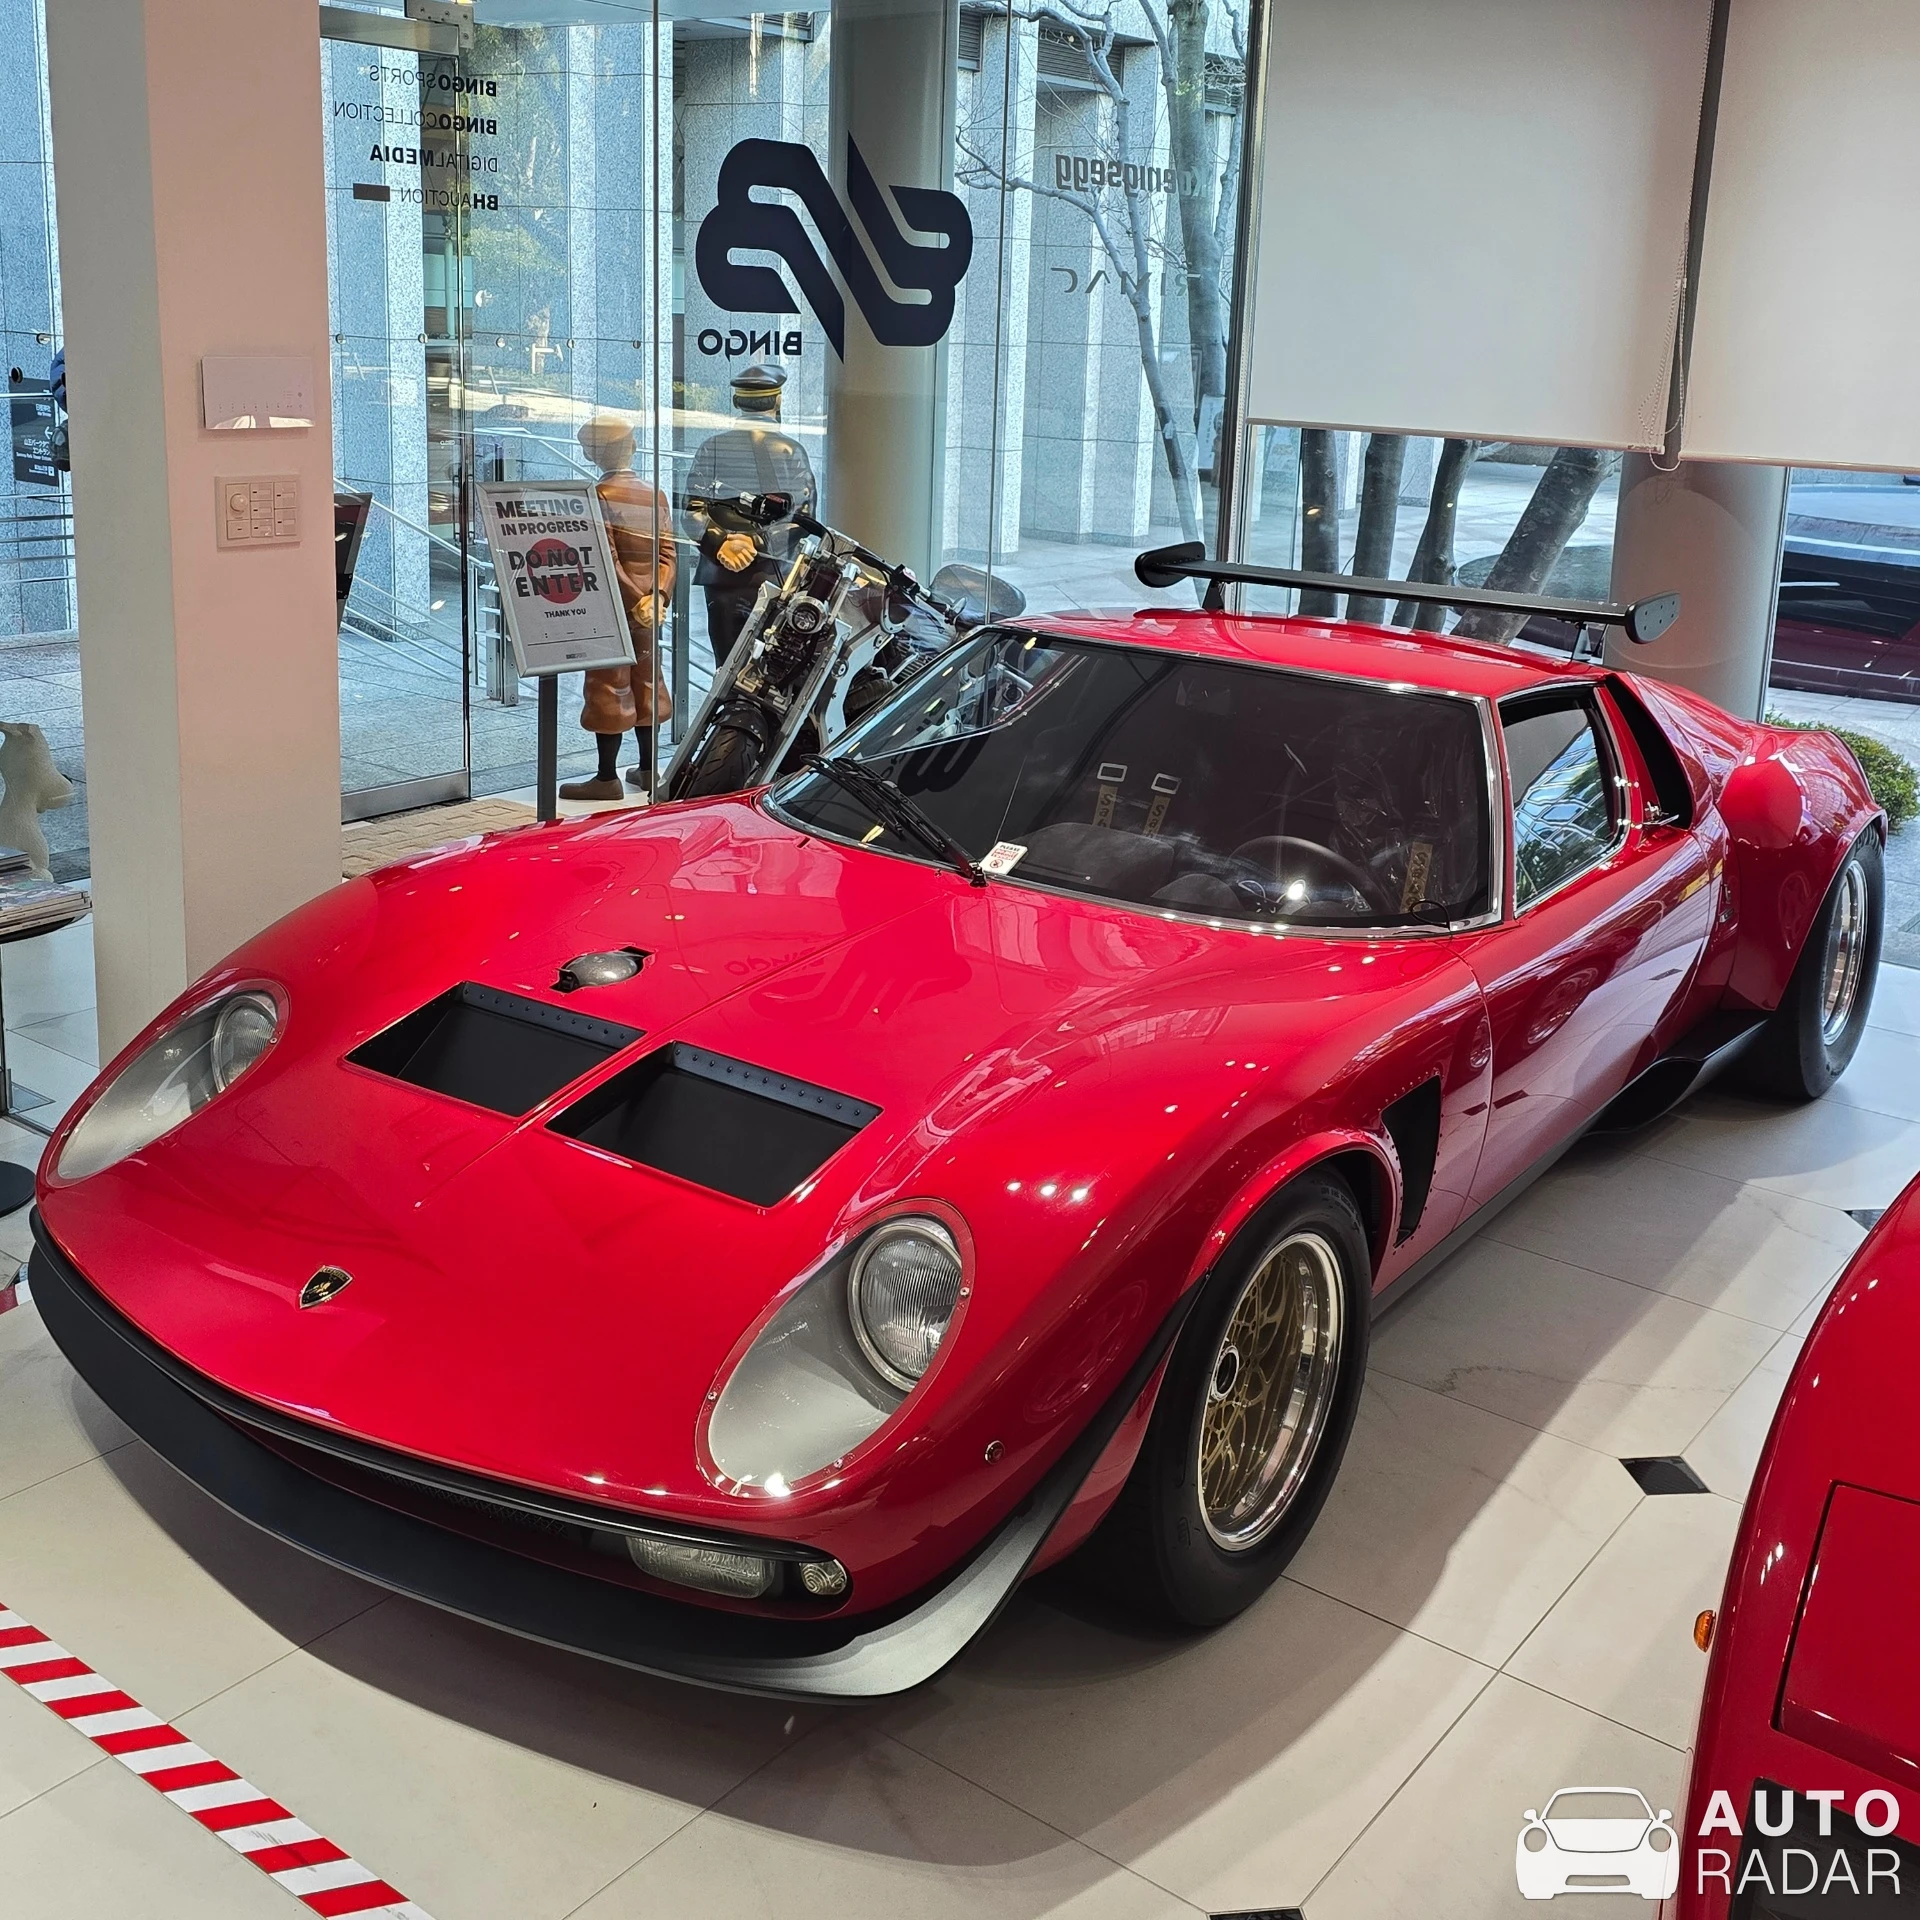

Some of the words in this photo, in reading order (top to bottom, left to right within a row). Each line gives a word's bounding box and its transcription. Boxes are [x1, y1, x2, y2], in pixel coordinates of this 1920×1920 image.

[495, 498, 584, 519] MEETING
[501, 523, 517, 536] IN
[519, 520, 589, 535] PROGRESS
[507, 549, 542, 570] DO
[547, 546, 592, 567] NOT
[516, 571, 599, 598] ENTER
[544, 609, 571, 619] THANK
[571, 608, 587, 616] YOU
